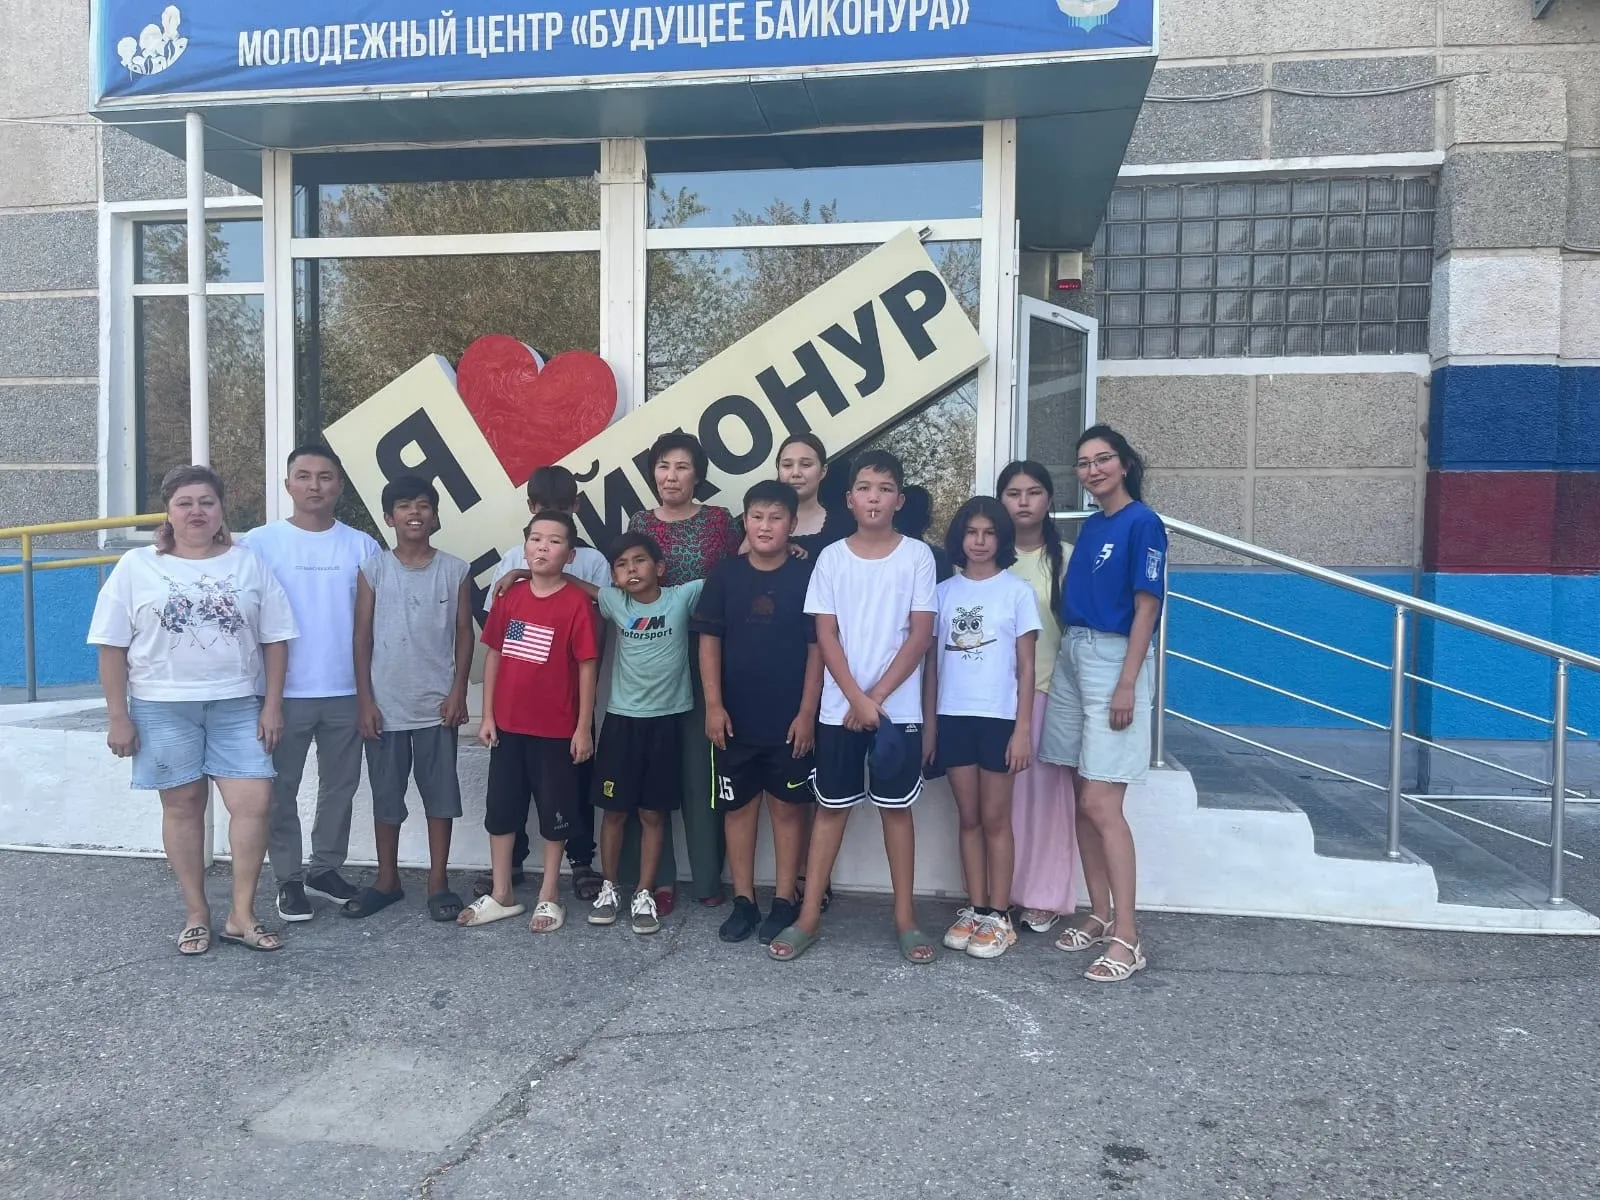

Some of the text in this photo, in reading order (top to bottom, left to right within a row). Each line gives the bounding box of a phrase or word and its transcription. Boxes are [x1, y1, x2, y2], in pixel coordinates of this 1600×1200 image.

[238, 9, 457, 67] МОЛОДЕЖНЫЙ
[465, 12, 563, 58] ЦЕНТР
[570, 2, 745, 51] «БУДУЩЕЕ
[470, 270, 947, 631] ЙОНУР
[718, 775, 735, 800] 15
